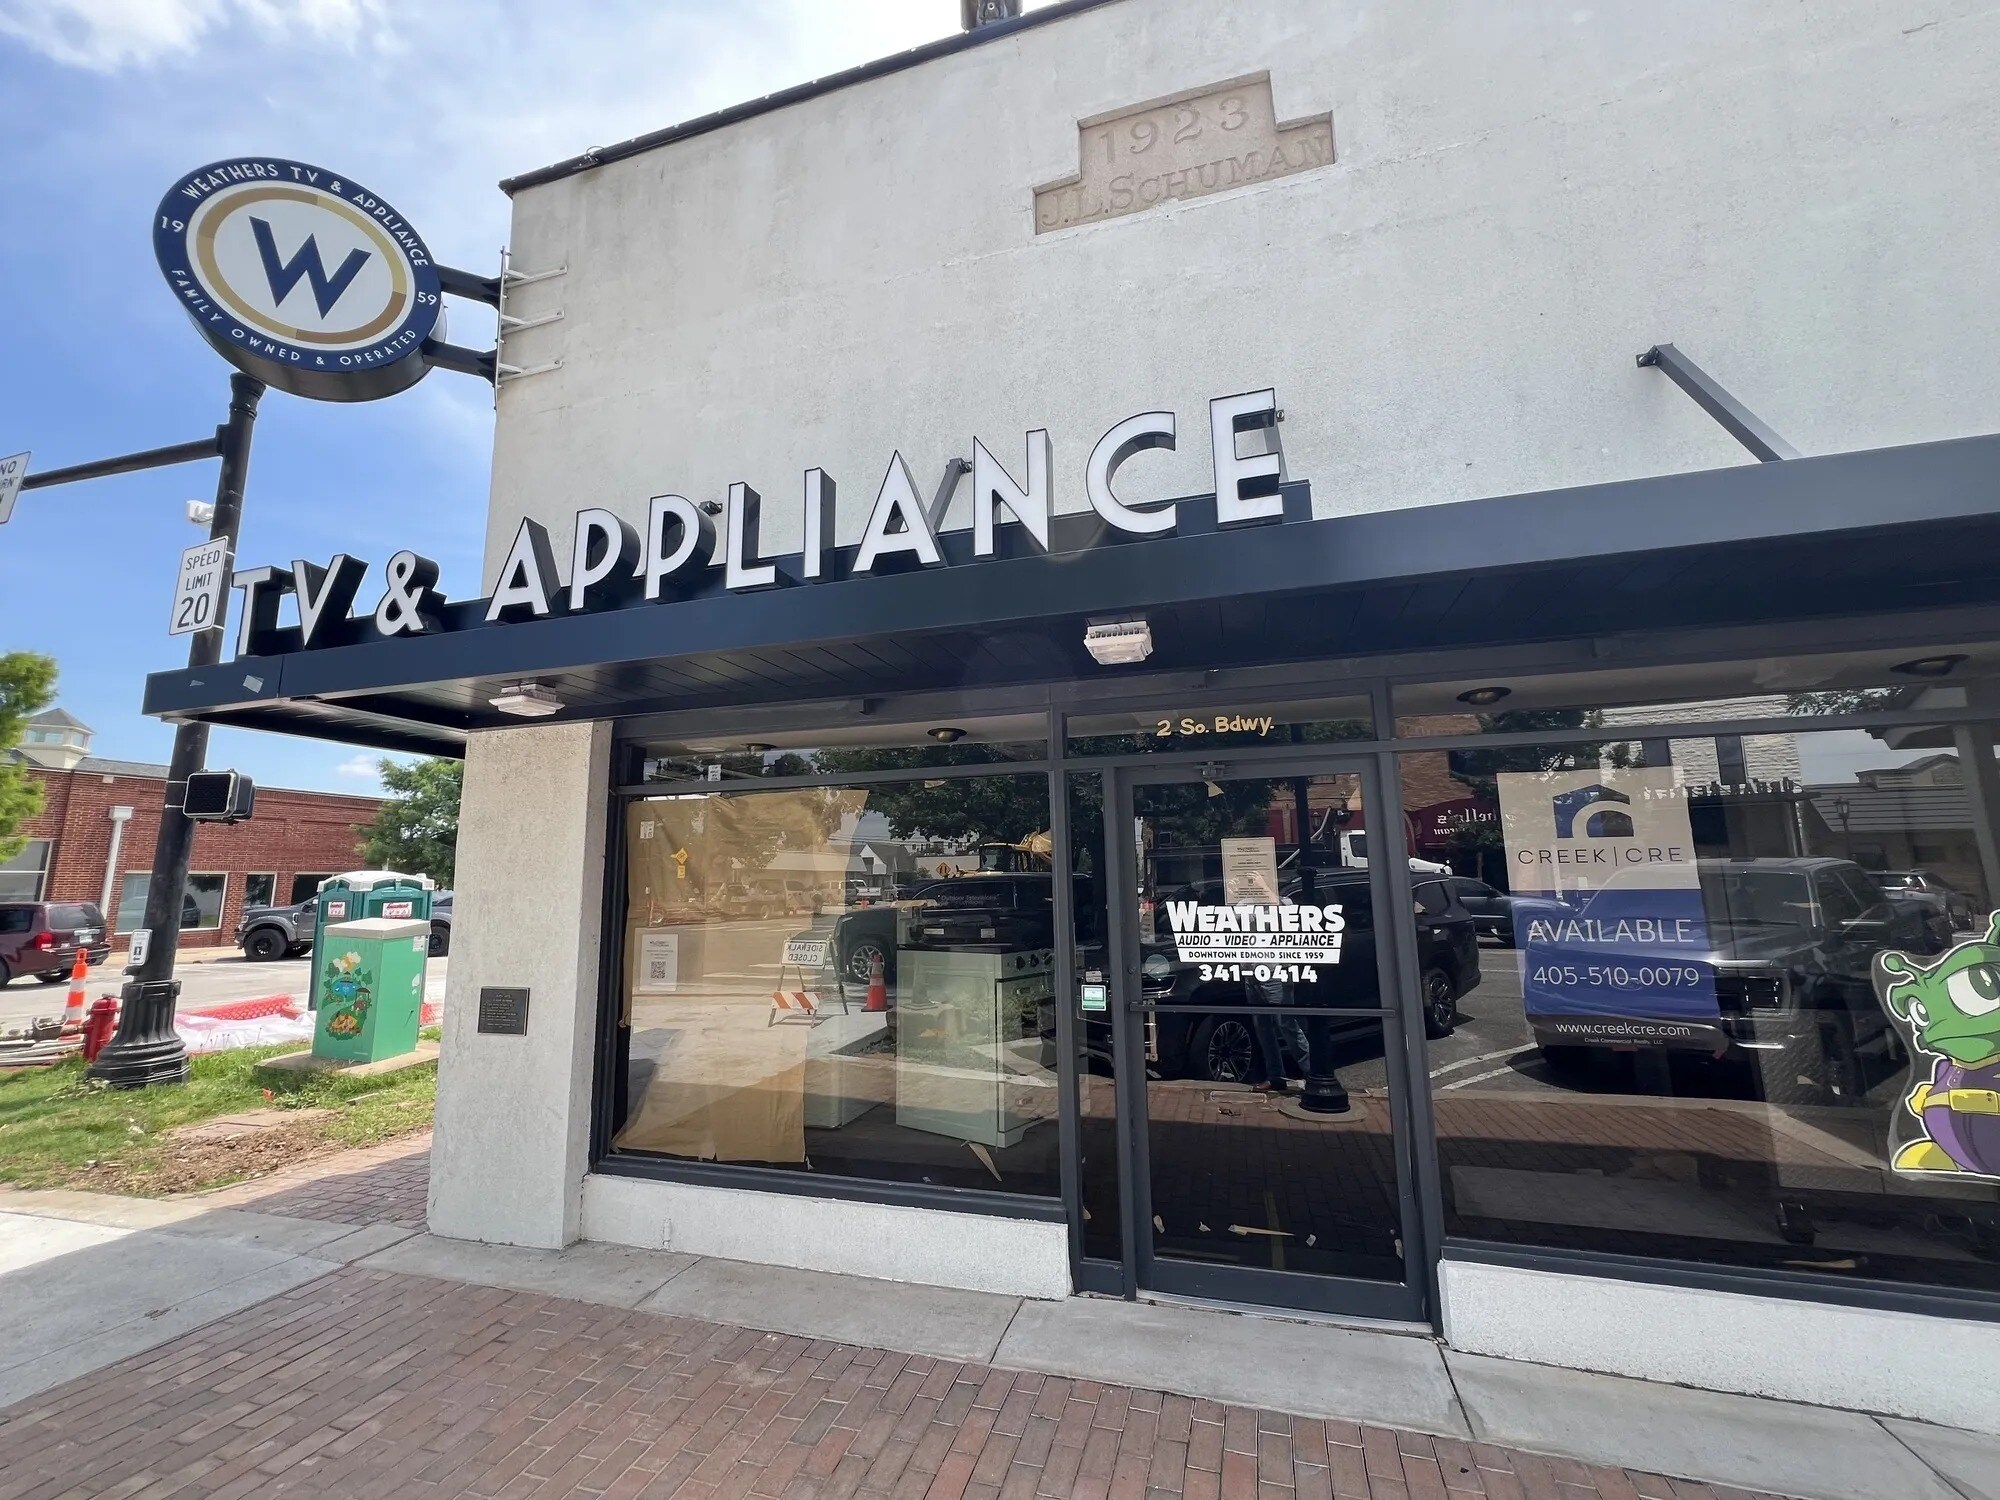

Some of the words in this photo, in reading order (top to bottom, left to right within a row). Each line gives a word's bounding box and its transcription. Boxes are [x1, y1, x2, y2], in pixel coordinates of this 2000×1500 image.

[1100, 96, 1249, 164] 1923
[160, 216, 184, 233] 19
[182, 163, 279, 200] WEATHERS
[290, 166, 319, 184] TV
[330, 180, 342, 193] &
[352, 193, 429, 267] APPLIANCE
[248, 215, 372, 321] W
[416, 291, 438, 306] 59
[171, 269, 223, 322] FAMILY
[231, 328, 300, 361] OWNED
[316, 356, 325, 366] &
[339, 329, 417, 366] OPERATED
[0, 461, 17, 475] NO
[231, 553, 354, 656] TV
[375, 550, 430, 637] &
[485, 387, 1284, 622] APPLIANCE
[185, 550, 220, 571] SPEED
[185, 572, 214, 591] LIMIT
[177, 593, 210, 628] 20
[1156, 719, 1172, 737] 2
[1180, 718, 1210, 736] So.
[1215, 715, 1275, 737] Bdwy.
[1166, 901, 1346, 933] WEATHERS
[1178, 934, 1212, 946] AUDIO
[1224, 934, 1257, 946] VIDEO
[1527, 919, 1695, 943] AVAILABLE
[1188, 951, 1238, 959] DOWNTOWN
[1240, 951, 1276, 959] EDMOND
[1279, 951, 1301, 959] SINCE
[1305, 951, 1324, 960] 1959
[1198, 964, 1318, 983] 341-0414
[1533, 966, 1700, 987] 405-510-0079
[1556, 1022, 1691, 1036] www.creekcre.com
